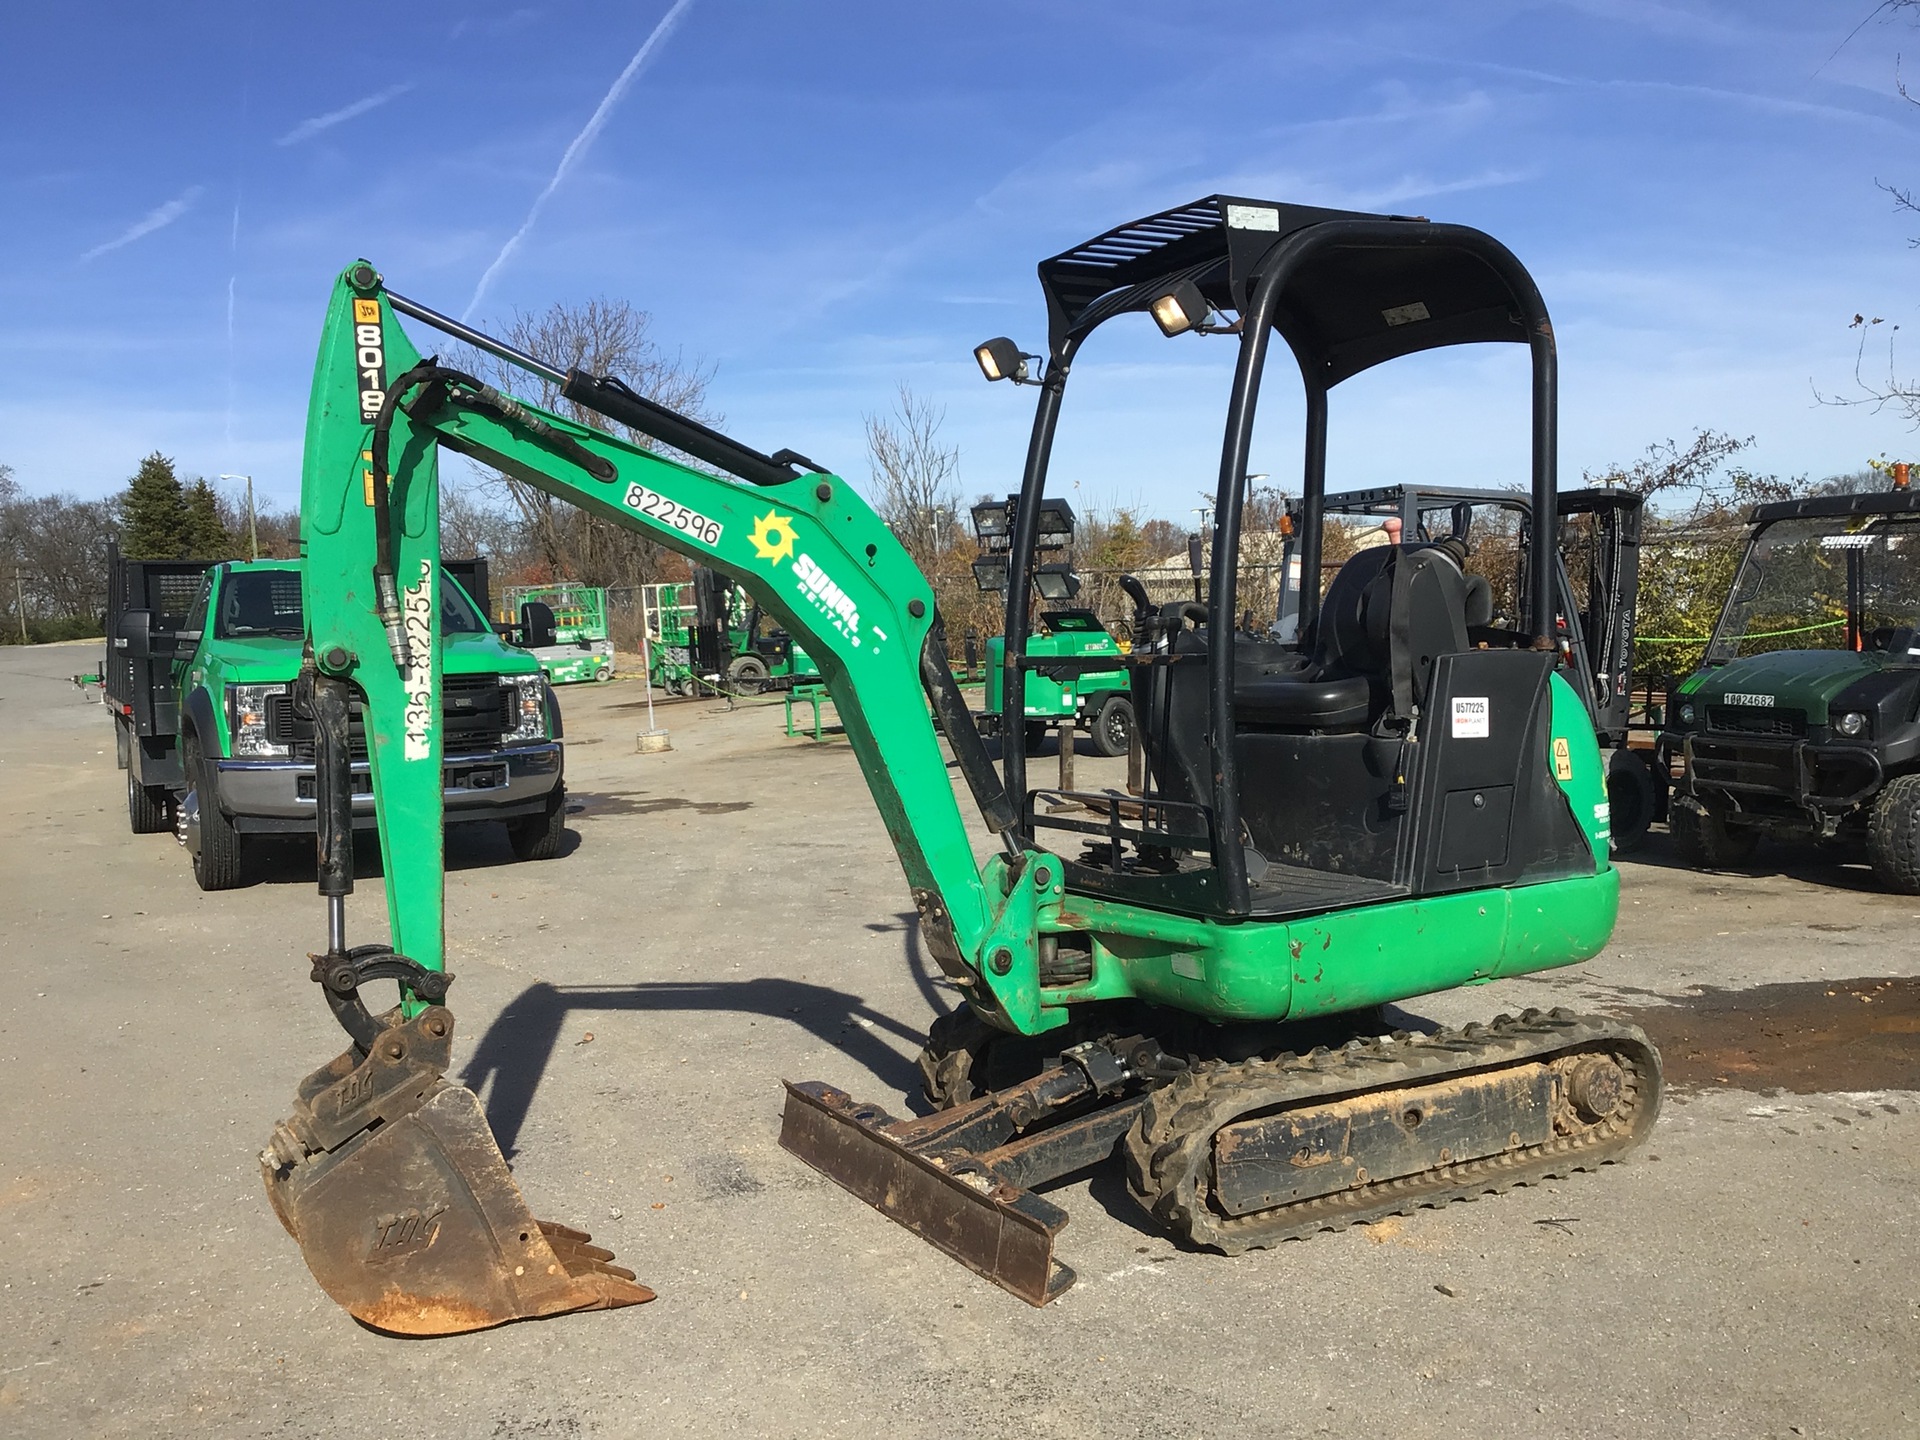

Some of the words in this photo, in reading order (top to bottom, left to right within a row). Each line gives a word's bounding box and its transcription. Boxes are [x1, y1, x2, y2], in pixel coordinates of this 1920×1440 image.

[357, 325, 385, 411] 8018
[627, 485, 720, 544] 822596
[1820, 535, 1876, 546] SUNBELT
[1619, 609, 1631, 669] TOYOTA
[1455, 702, 1485, 714] U577225
[1725, 694, 1773, 707] 10024682
